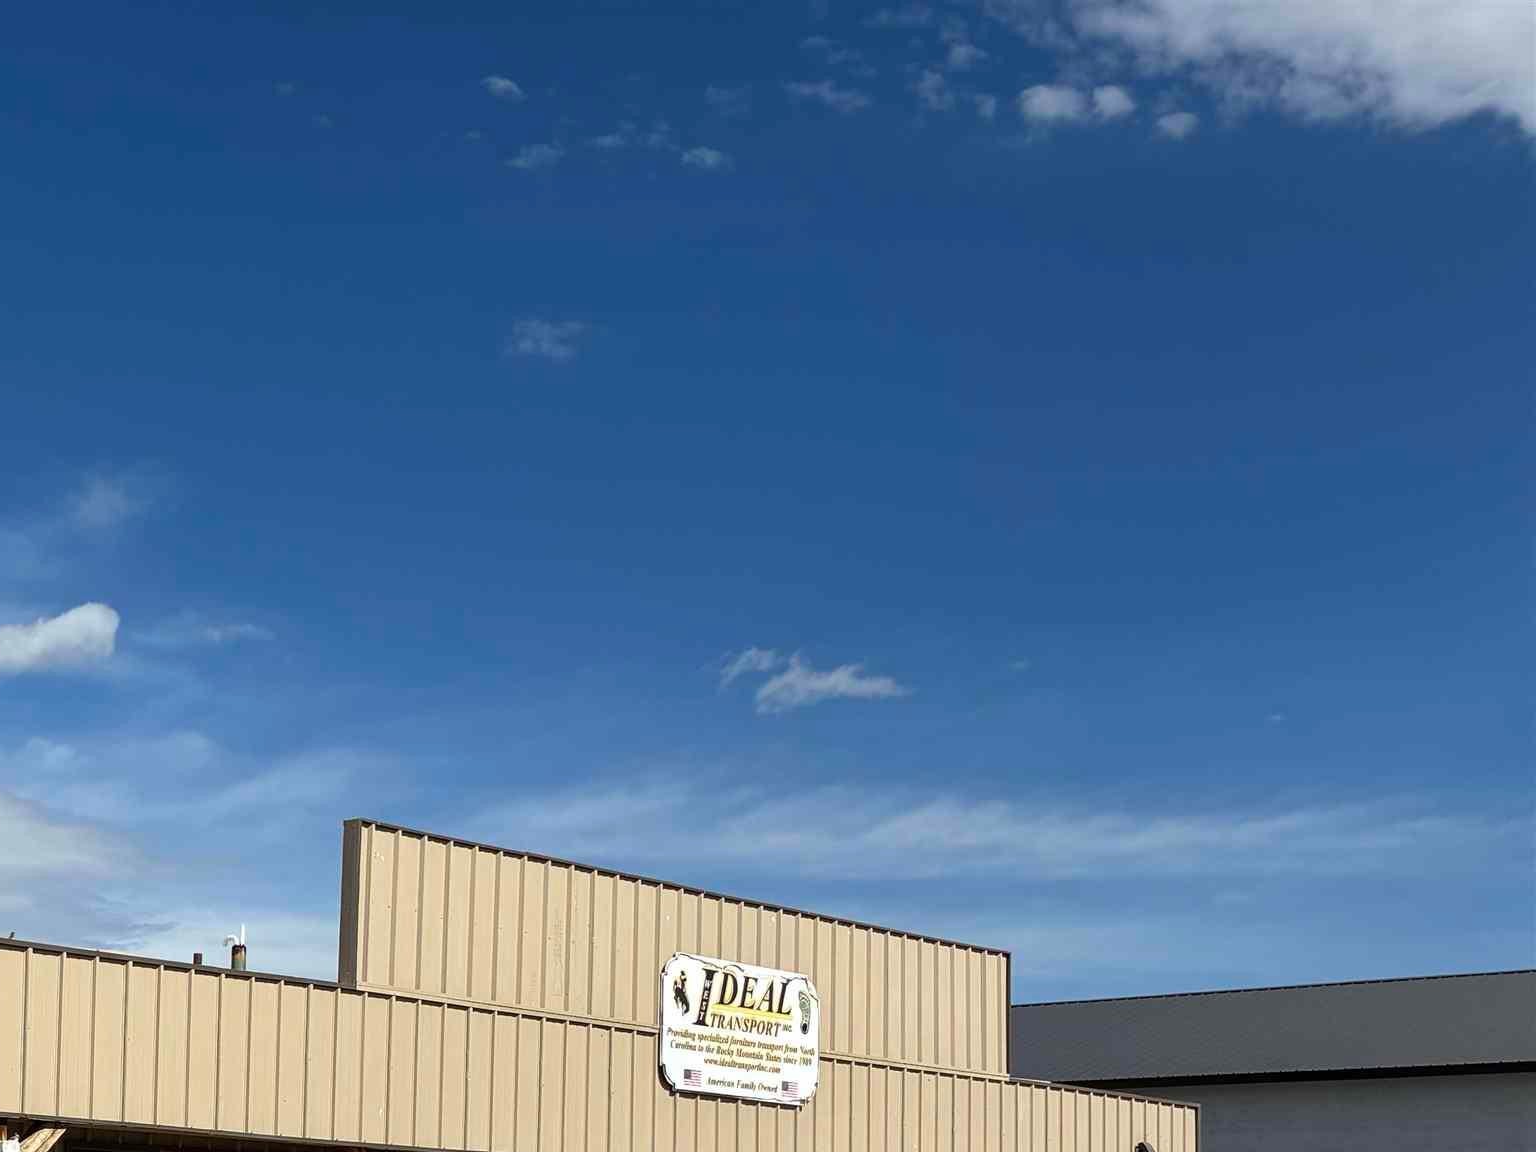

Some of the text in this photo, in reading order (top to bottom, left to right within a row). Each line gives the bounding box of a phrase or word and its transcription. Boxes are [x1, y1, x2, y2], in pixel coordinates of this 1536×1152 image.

[692, 968, 793, 1027] IDEAL
[698, 980, 713, 1021] WEST
[711, 1013, 782, 1037] TRANSPORT
[666, 1027, 816, 1057] Providing specialized furniture transport from North
[670, 1039, 697, 1051] Carolina
[697, 1044, 704, 1052] to
[705, 1044, 715, 1053] the
[716, 1045, 734, 1058] Rocky
[735, 1047, 764, 1061] Mountain
[765, 1051, 782, 1063] States
[783, 1056, 797, 1065] since
[707, 1076, 778, 1093] American Family Owned
